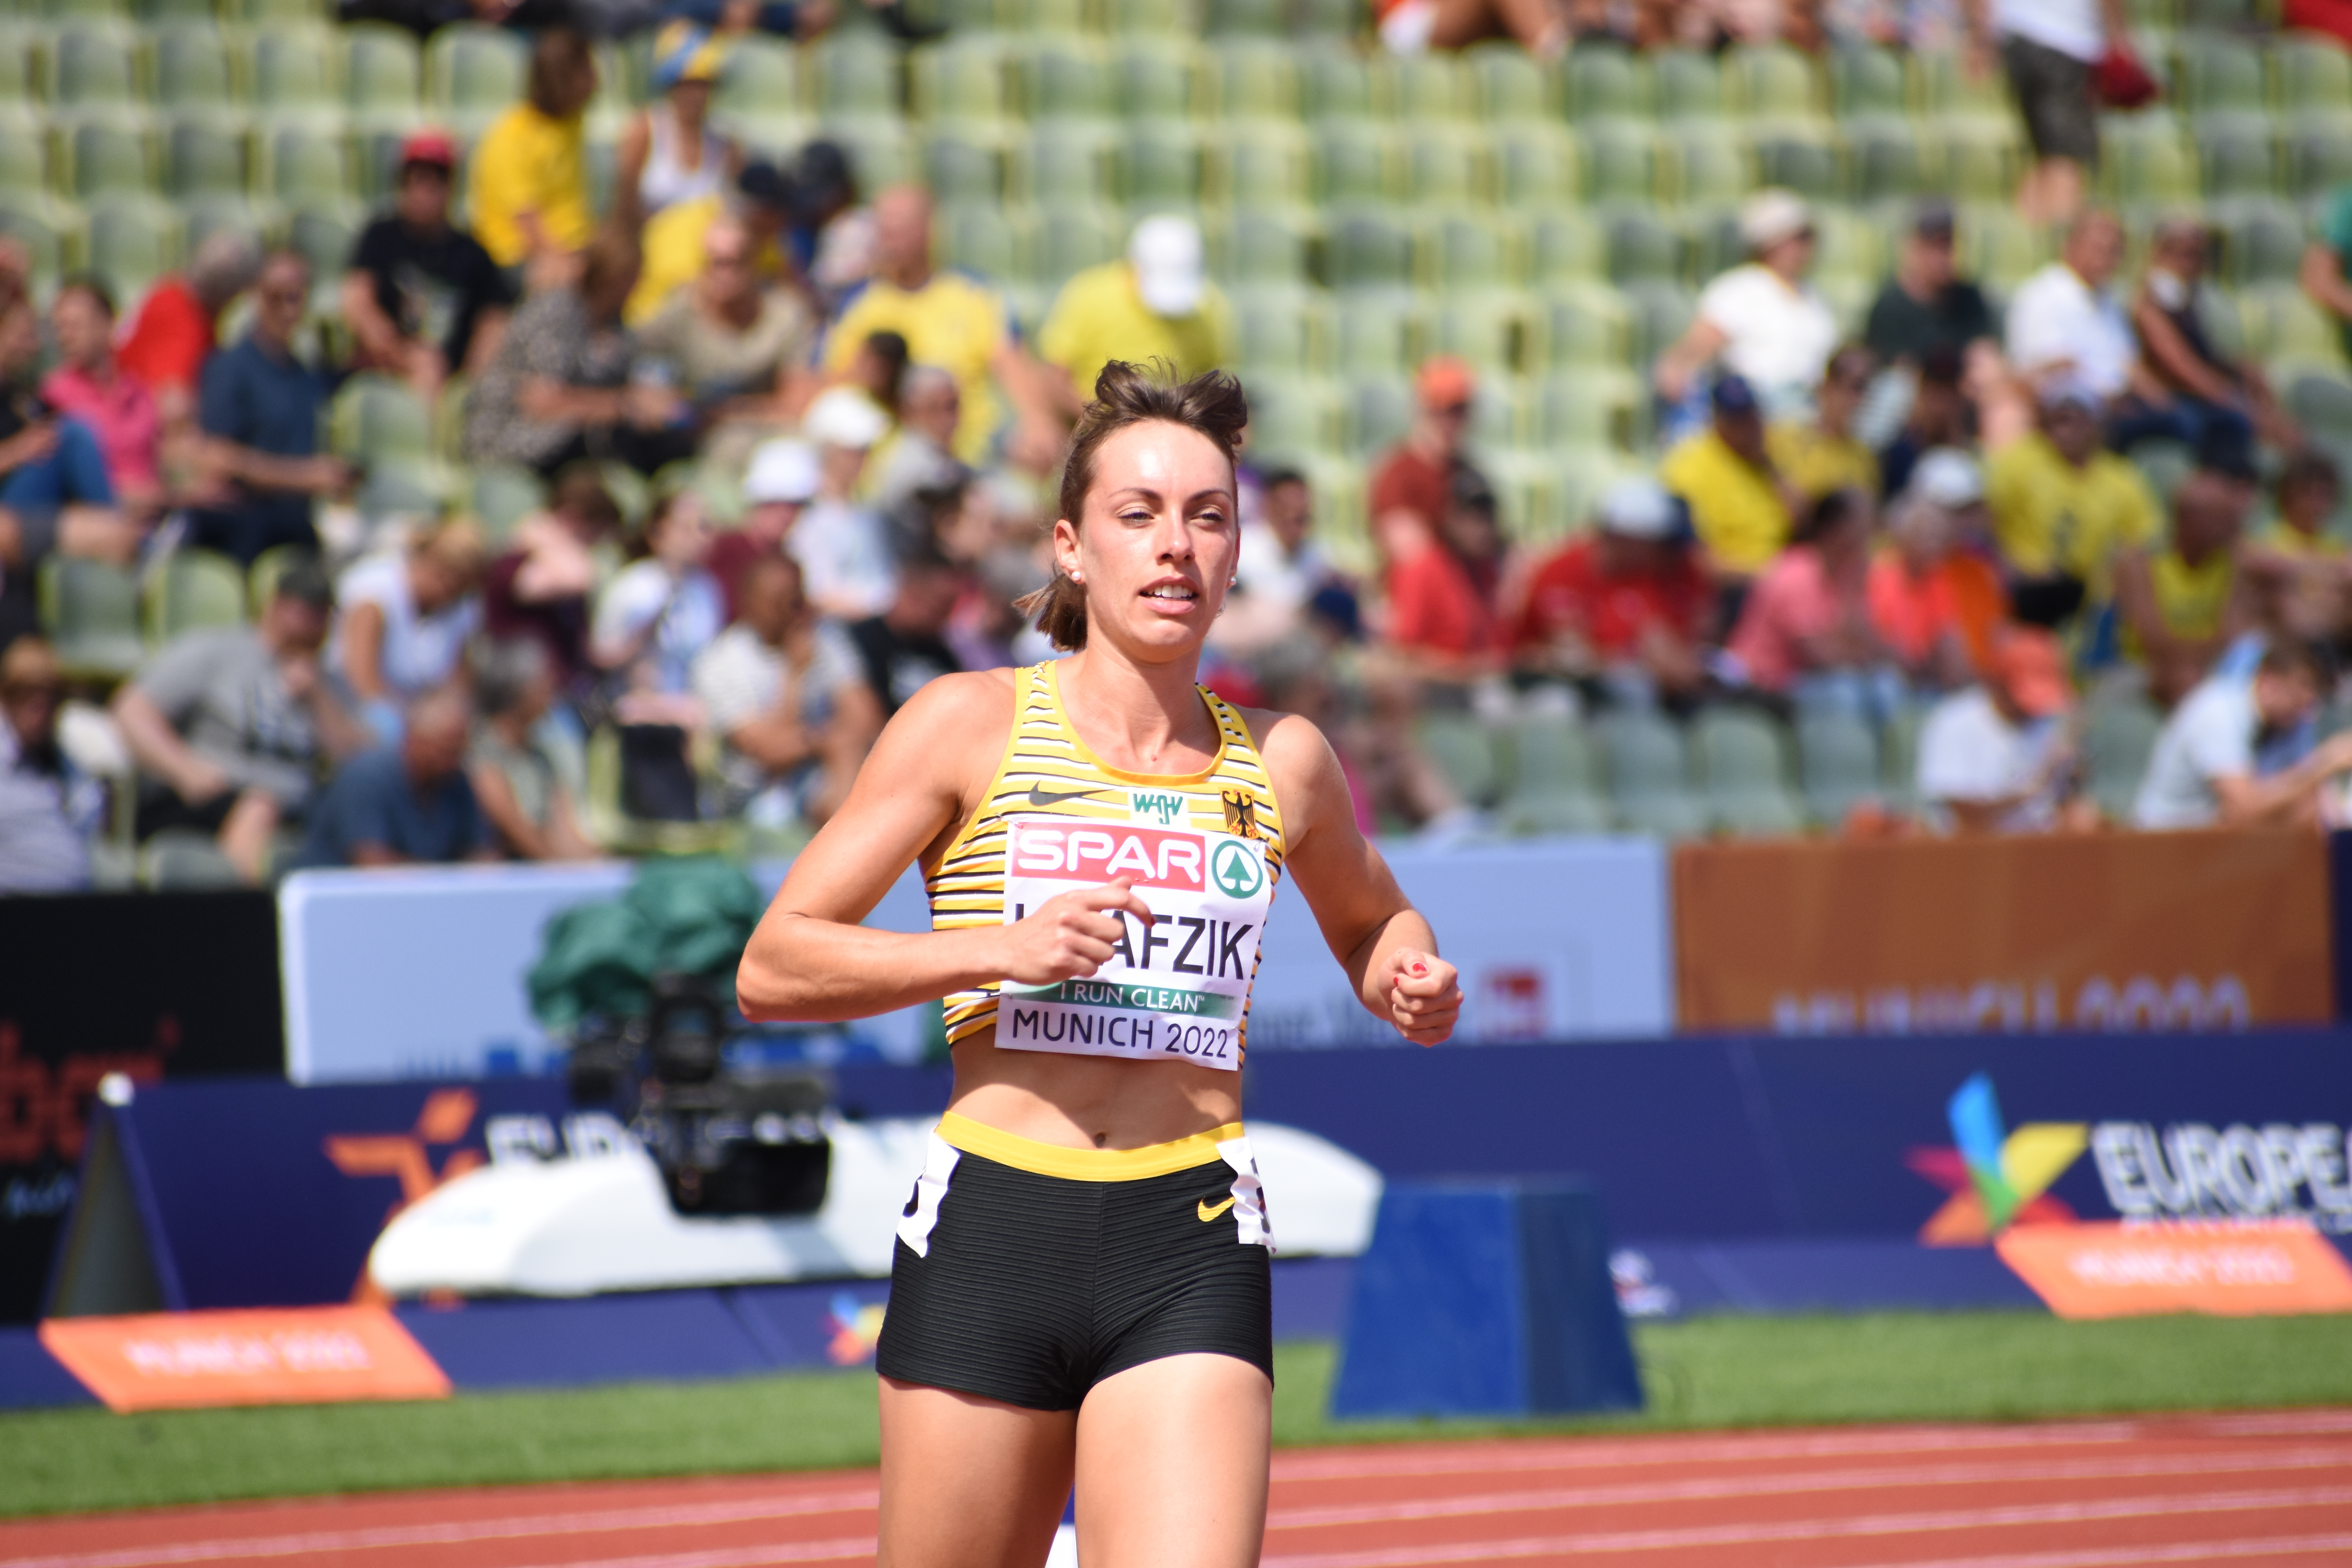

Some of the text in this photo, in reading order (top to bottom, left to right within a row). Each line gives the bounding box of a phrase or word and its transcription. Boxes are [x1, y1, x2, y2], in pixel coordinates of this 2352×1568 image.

[1018, 829, 1201, 884] SPAR
[1015, 903, 1254, 980] AFZIK
[1060, 983, 1065, 1000] I
[1074, 984, 1123, 1005] RUN
[1012, 1009, 1227, 1058] MUNICH 2022
[2091, 1121, 2352, 1214] EUROPE
